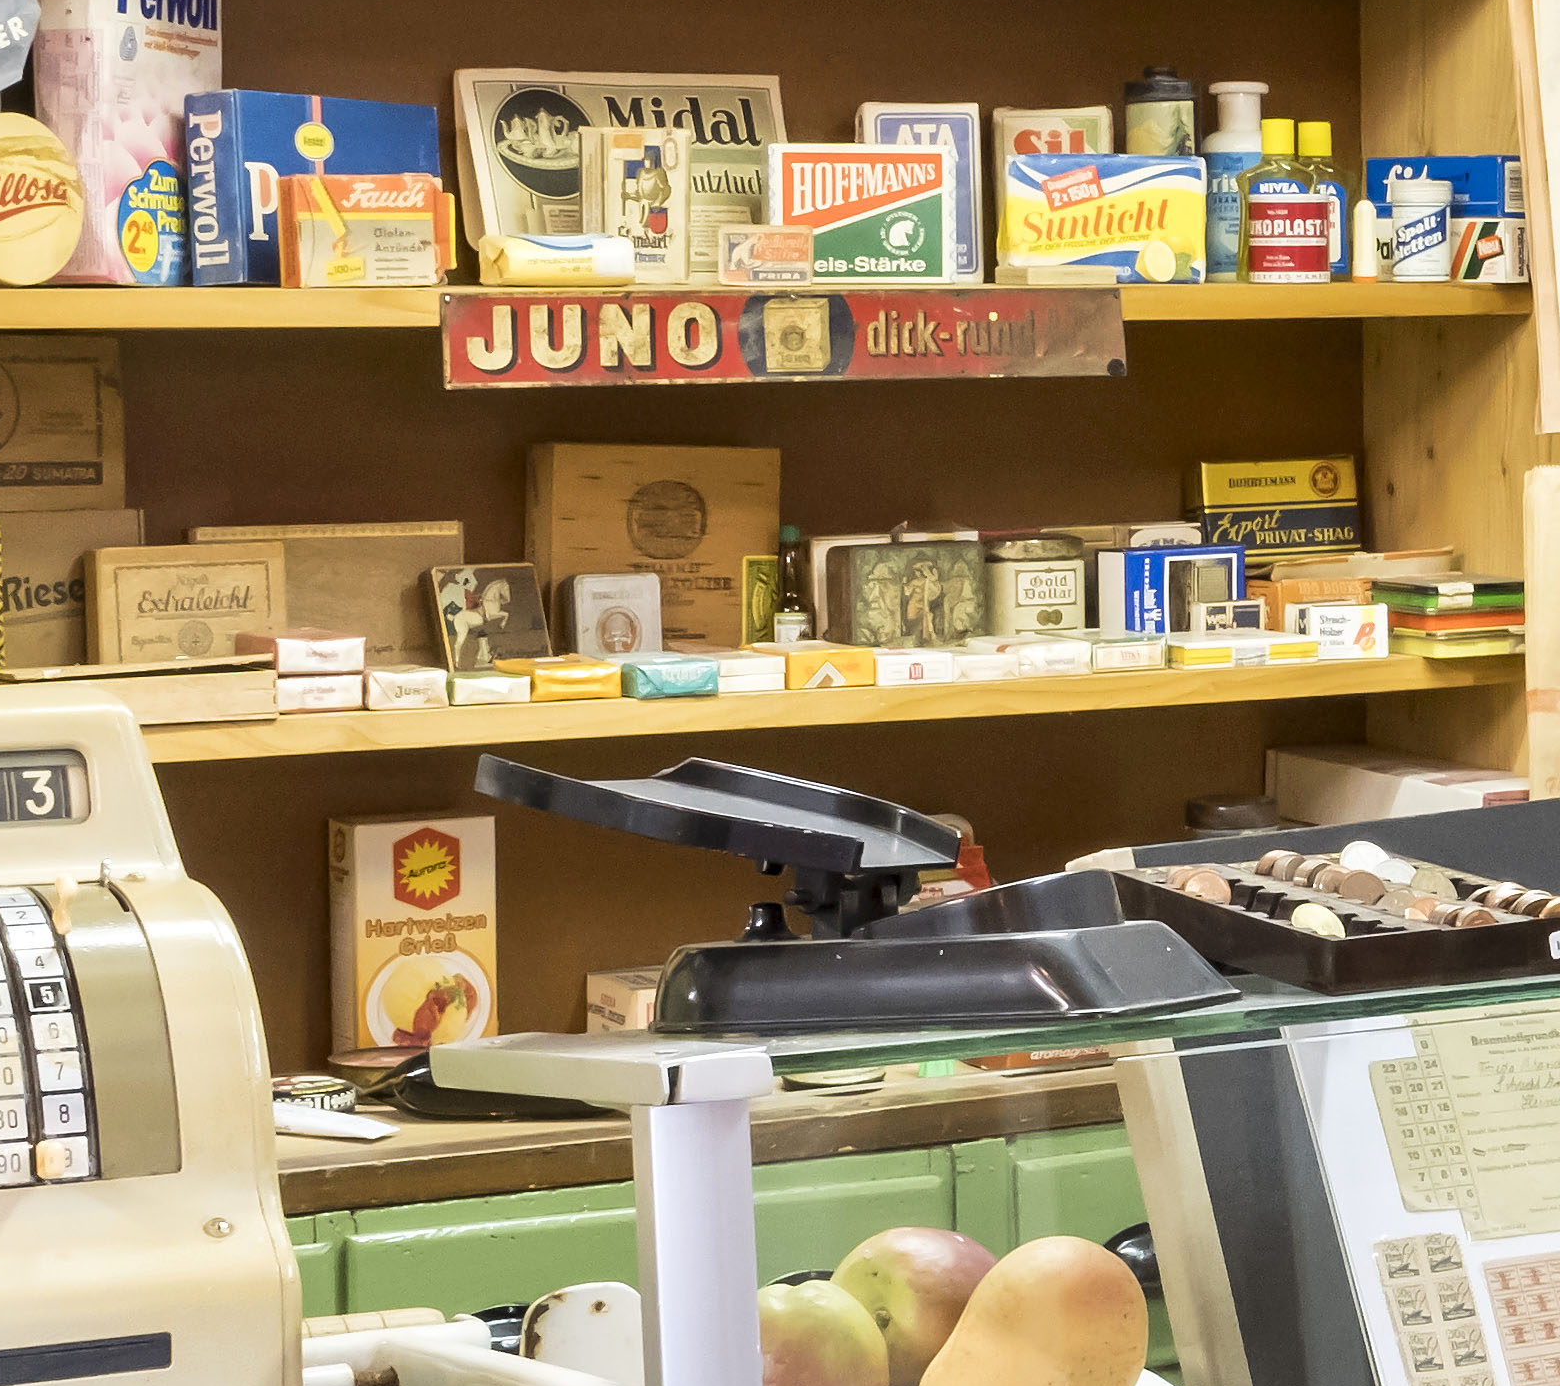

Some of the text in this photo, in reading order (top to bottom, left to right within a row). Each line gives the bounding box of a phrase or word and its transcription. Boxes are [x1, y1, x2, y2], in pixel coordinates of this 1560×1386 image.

[149, 169, 178, 192] Zum
[189, 110, 229, 270] Perwoll
[791, 162, 936, 217] HOFFMANNS
[1259, 182, 1300, 194] NIVEA
[1023, 199, 1168, 244] Sunlicht
[758, 272, 801, 280] PRIMA
[815, 255, 926, 273] eis-Stärke
[465, 302, 719, 371] JUNO
[1213, 511, 1354, 545] Export PRIVAT-SHAG
[138, 585, 253, 613] Extraleicht
[365, 913, 488, 938] Hartweizen
[399, 935, 457, 957] Grieß
